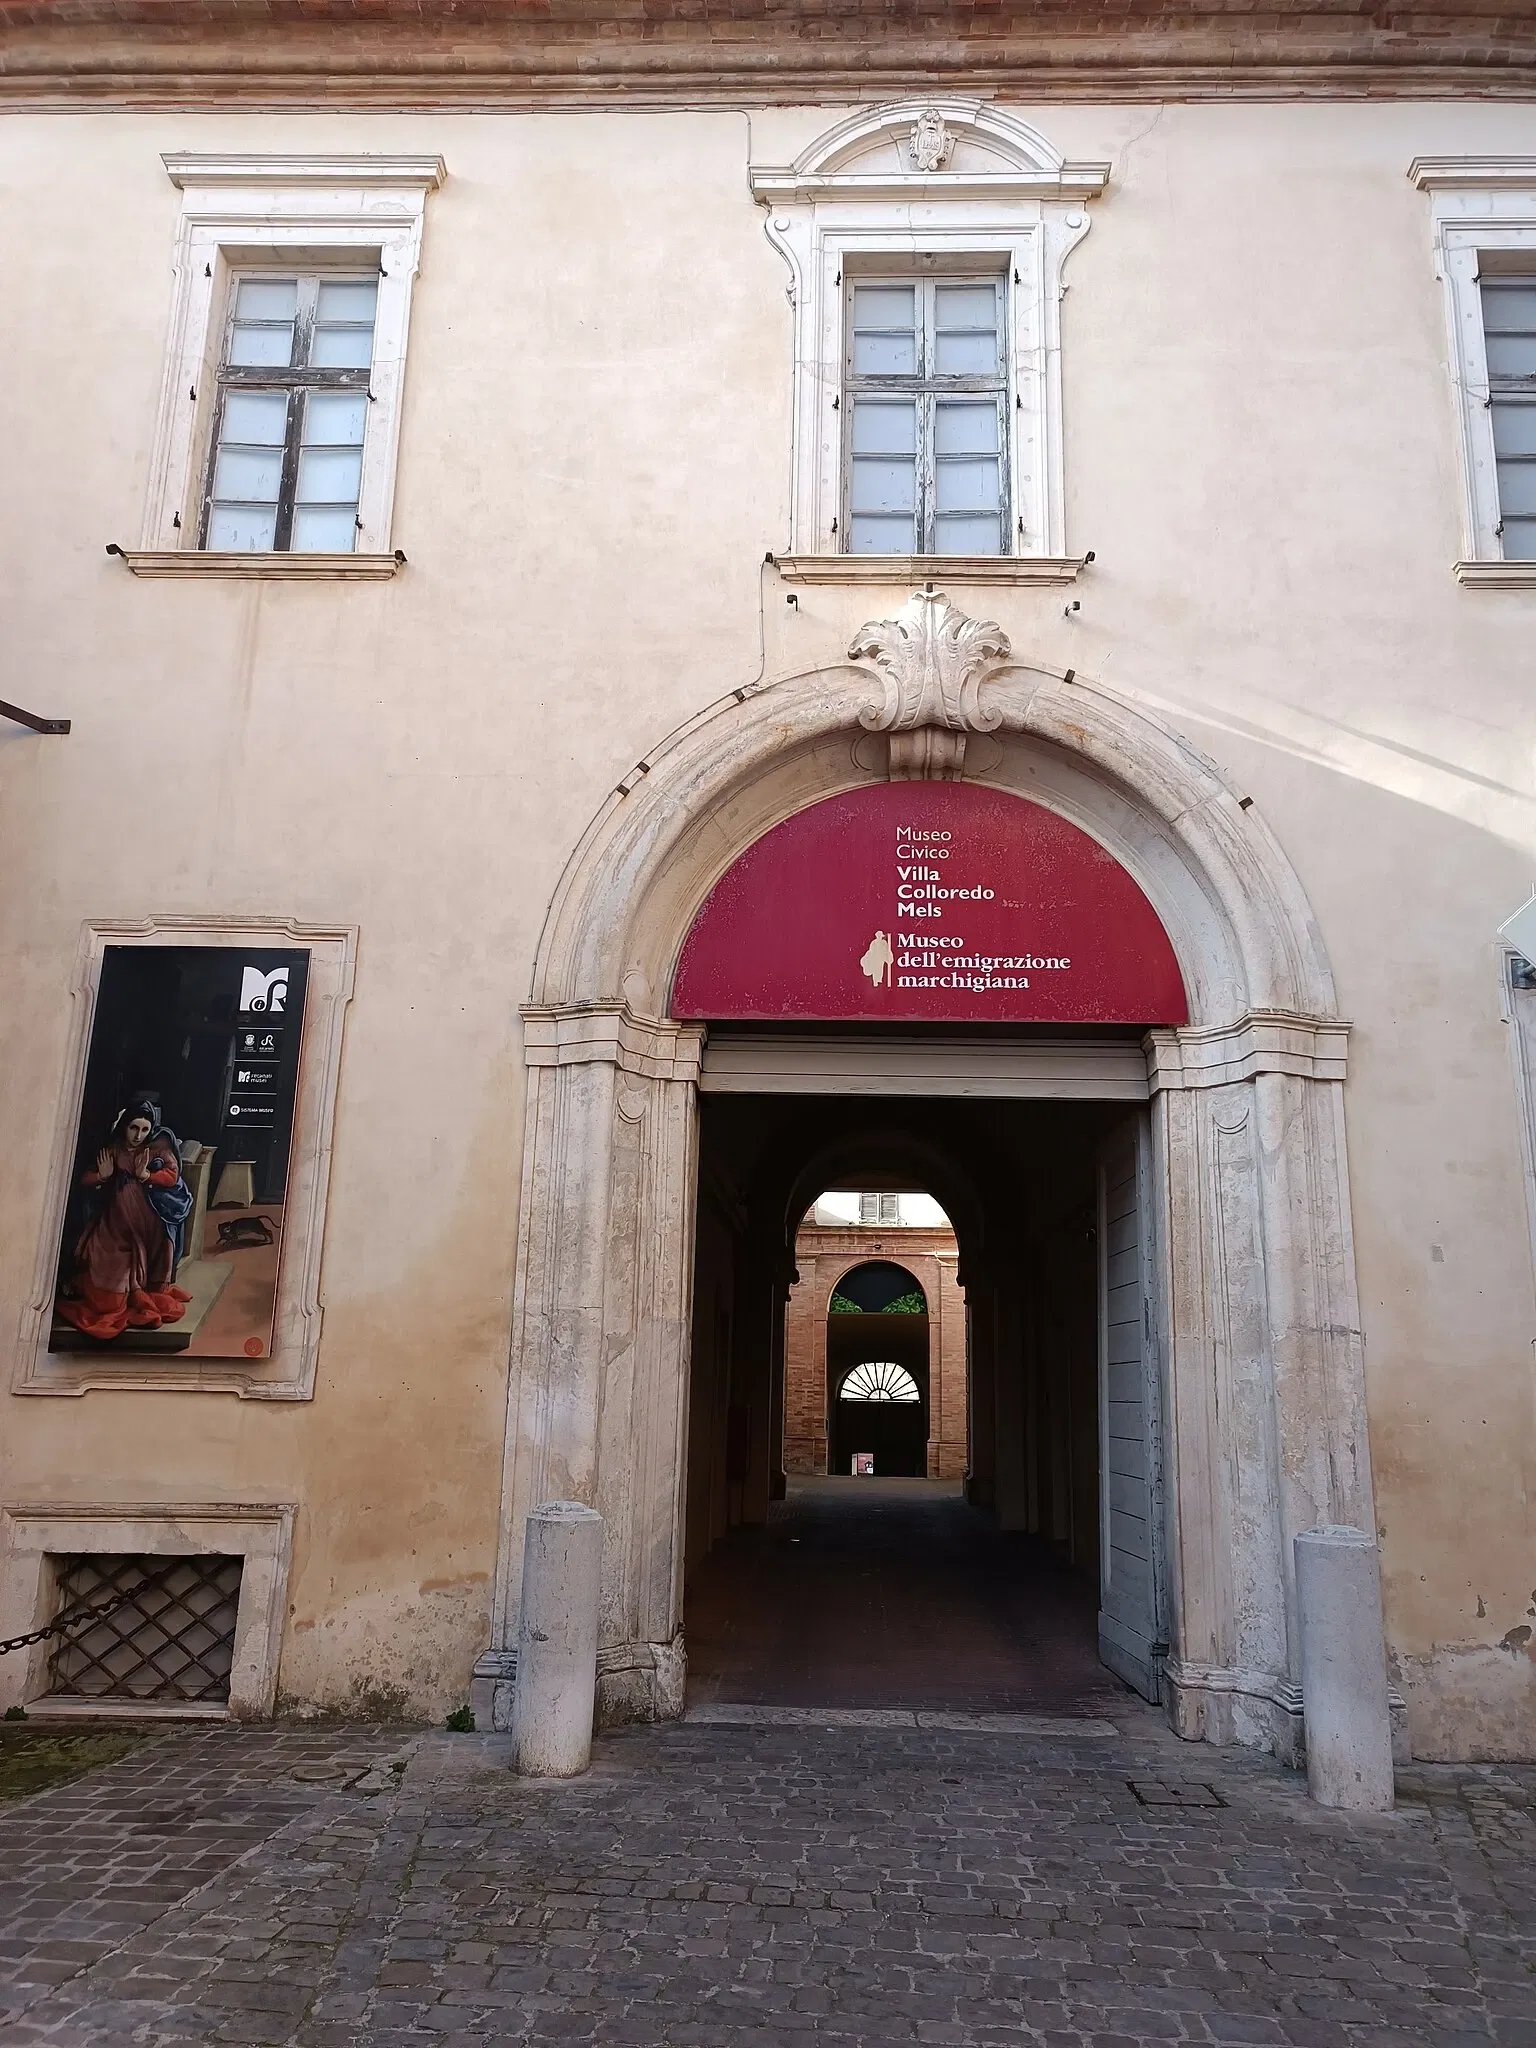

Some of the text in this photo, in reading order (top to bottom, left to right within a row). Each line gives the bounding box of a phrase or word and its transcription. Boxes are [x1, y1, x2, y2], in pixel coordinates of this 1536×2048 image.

[896, 826, 952, 841] Museo
[896, 844, 950, 859] Civico
[897, 866, 941, 881] Villa
[897, 884, 995, 900] Colloredo
[897, 902, 942, 917] Mels
[897, 933, 964, 948] Museo
[897, 952, 1071, 972] dell'emigrazione
[897, 972, 1030, 993] marchigiana
